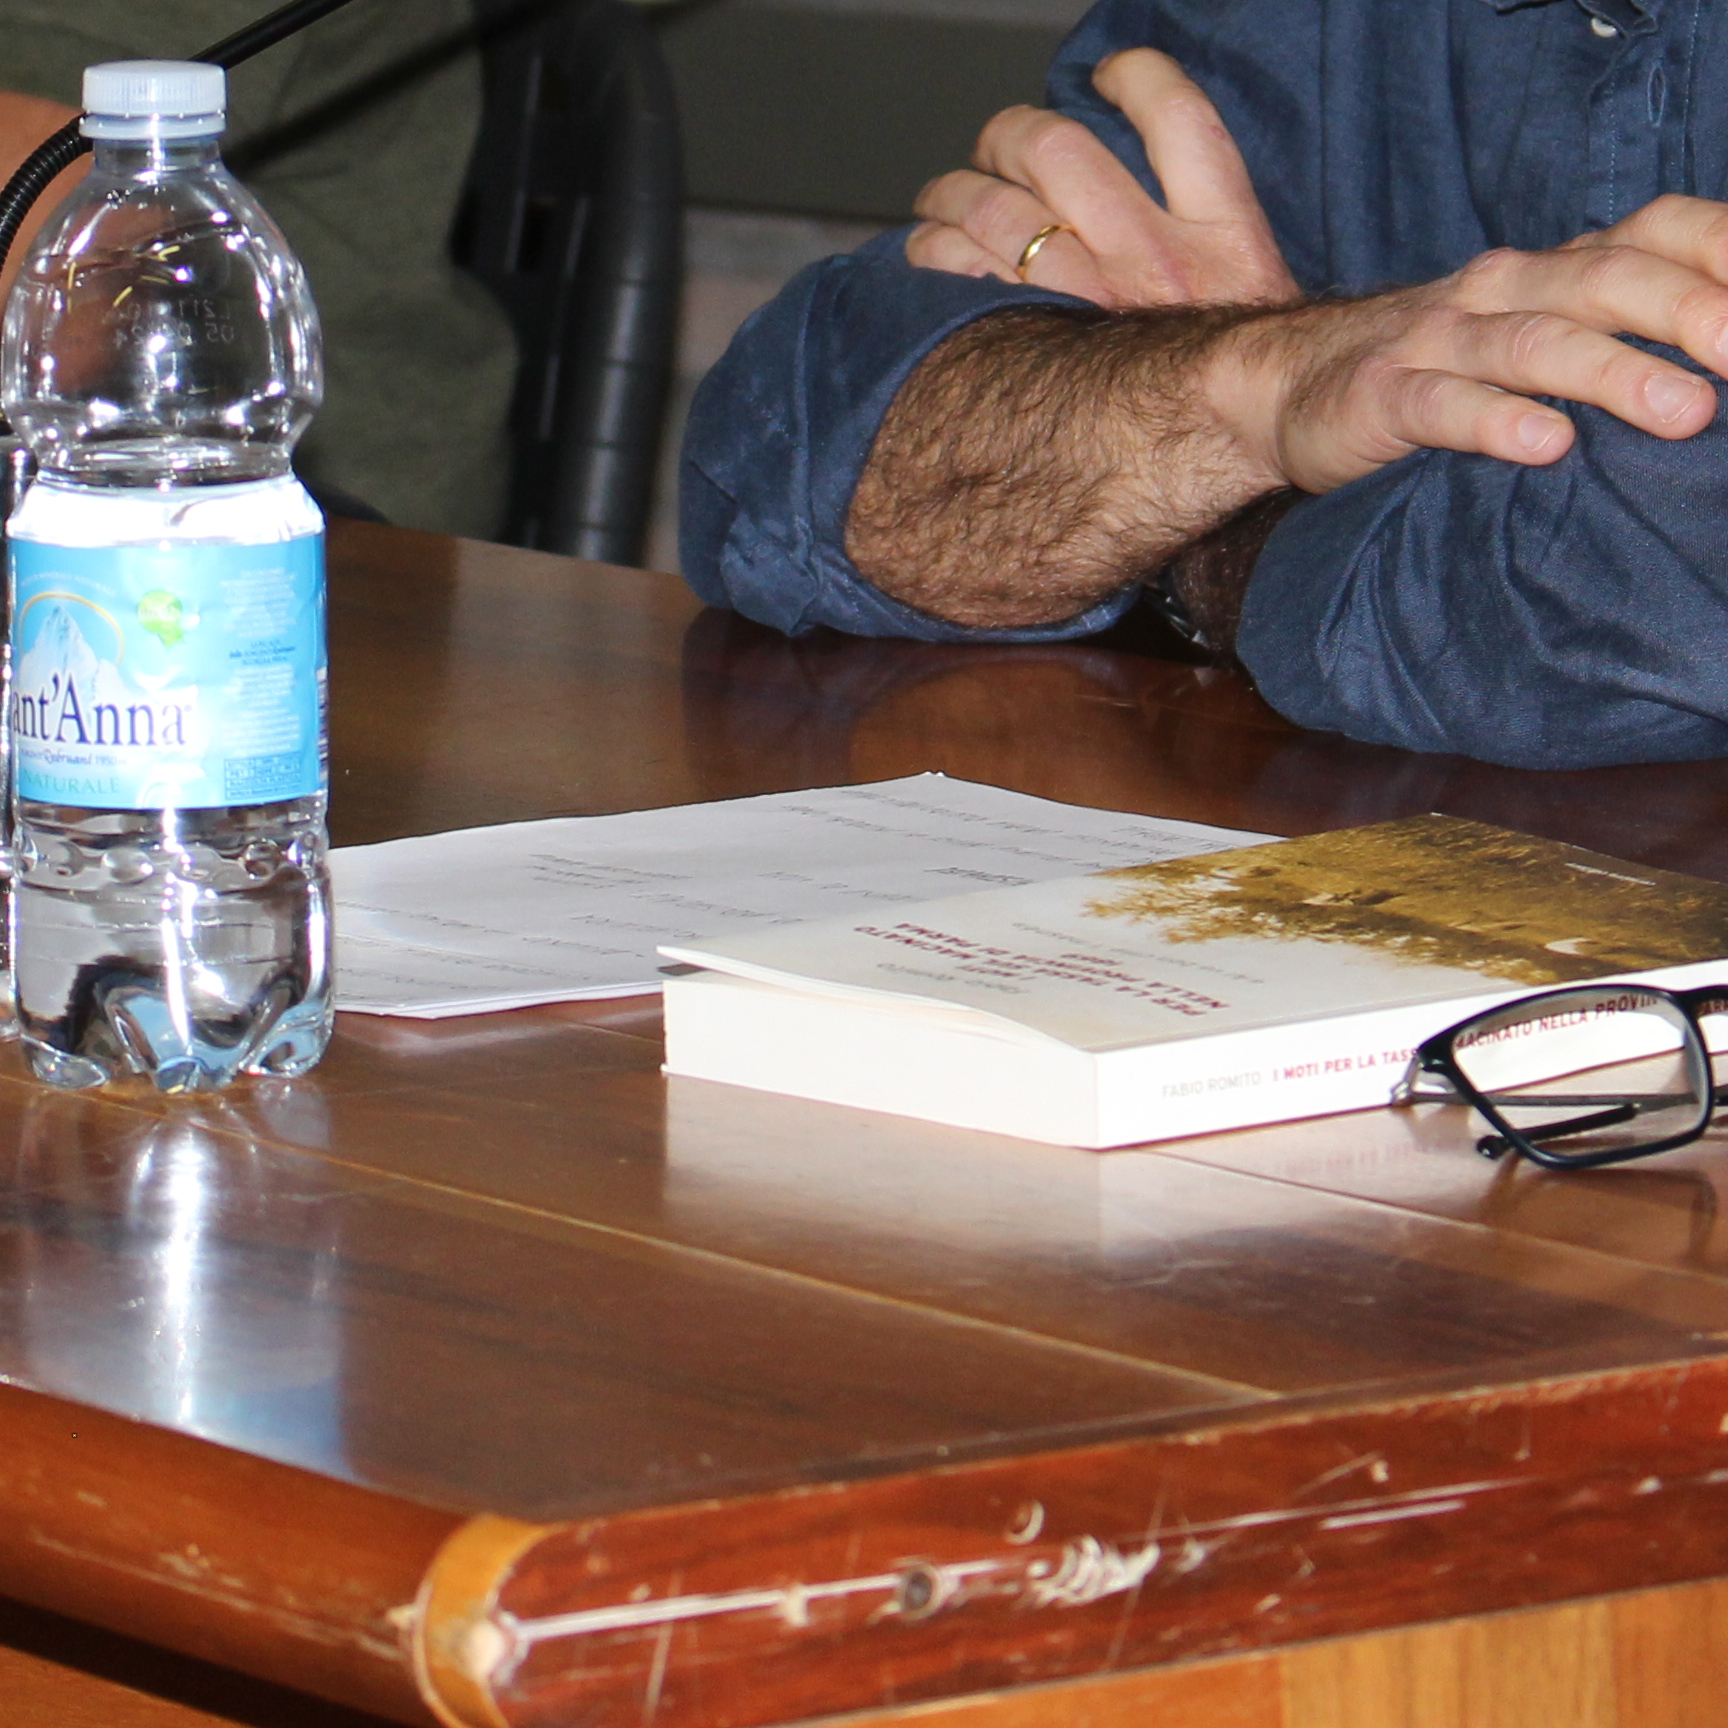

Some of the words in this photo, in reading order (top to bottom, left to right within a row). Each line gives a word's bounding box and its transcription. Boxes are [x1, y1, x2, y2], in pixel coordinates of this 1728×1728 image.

[12, 672, 186, 746] ant'Anna
[24, 768, 121, 795] NATURALE
[854, 926, 974, 959] MACINATO
[894, 923, 980, 948] PARMA
[1012, 955, 1143, 981] PROVINCIA
[1116, 986, 1153, 997] LA
[1146, 982, 1231, 1008] NELLA
[1152, 998, 1208, 1016] PER
[1162, 1081, 1204, 1098] FABIO
[1208, 1072, 1262, 1092] ROMITO
[1273, 1069, 1279, 1081] I
[1284, 1063, 1319, 1079] MOTI
[1325, 1057, 1352, 1073] PER
[1358, 1053, 1376, 1069] LA
[1382, 1048, 1417, 1065] TASS
[1540, 1008, 1589, 1032] NELLA
